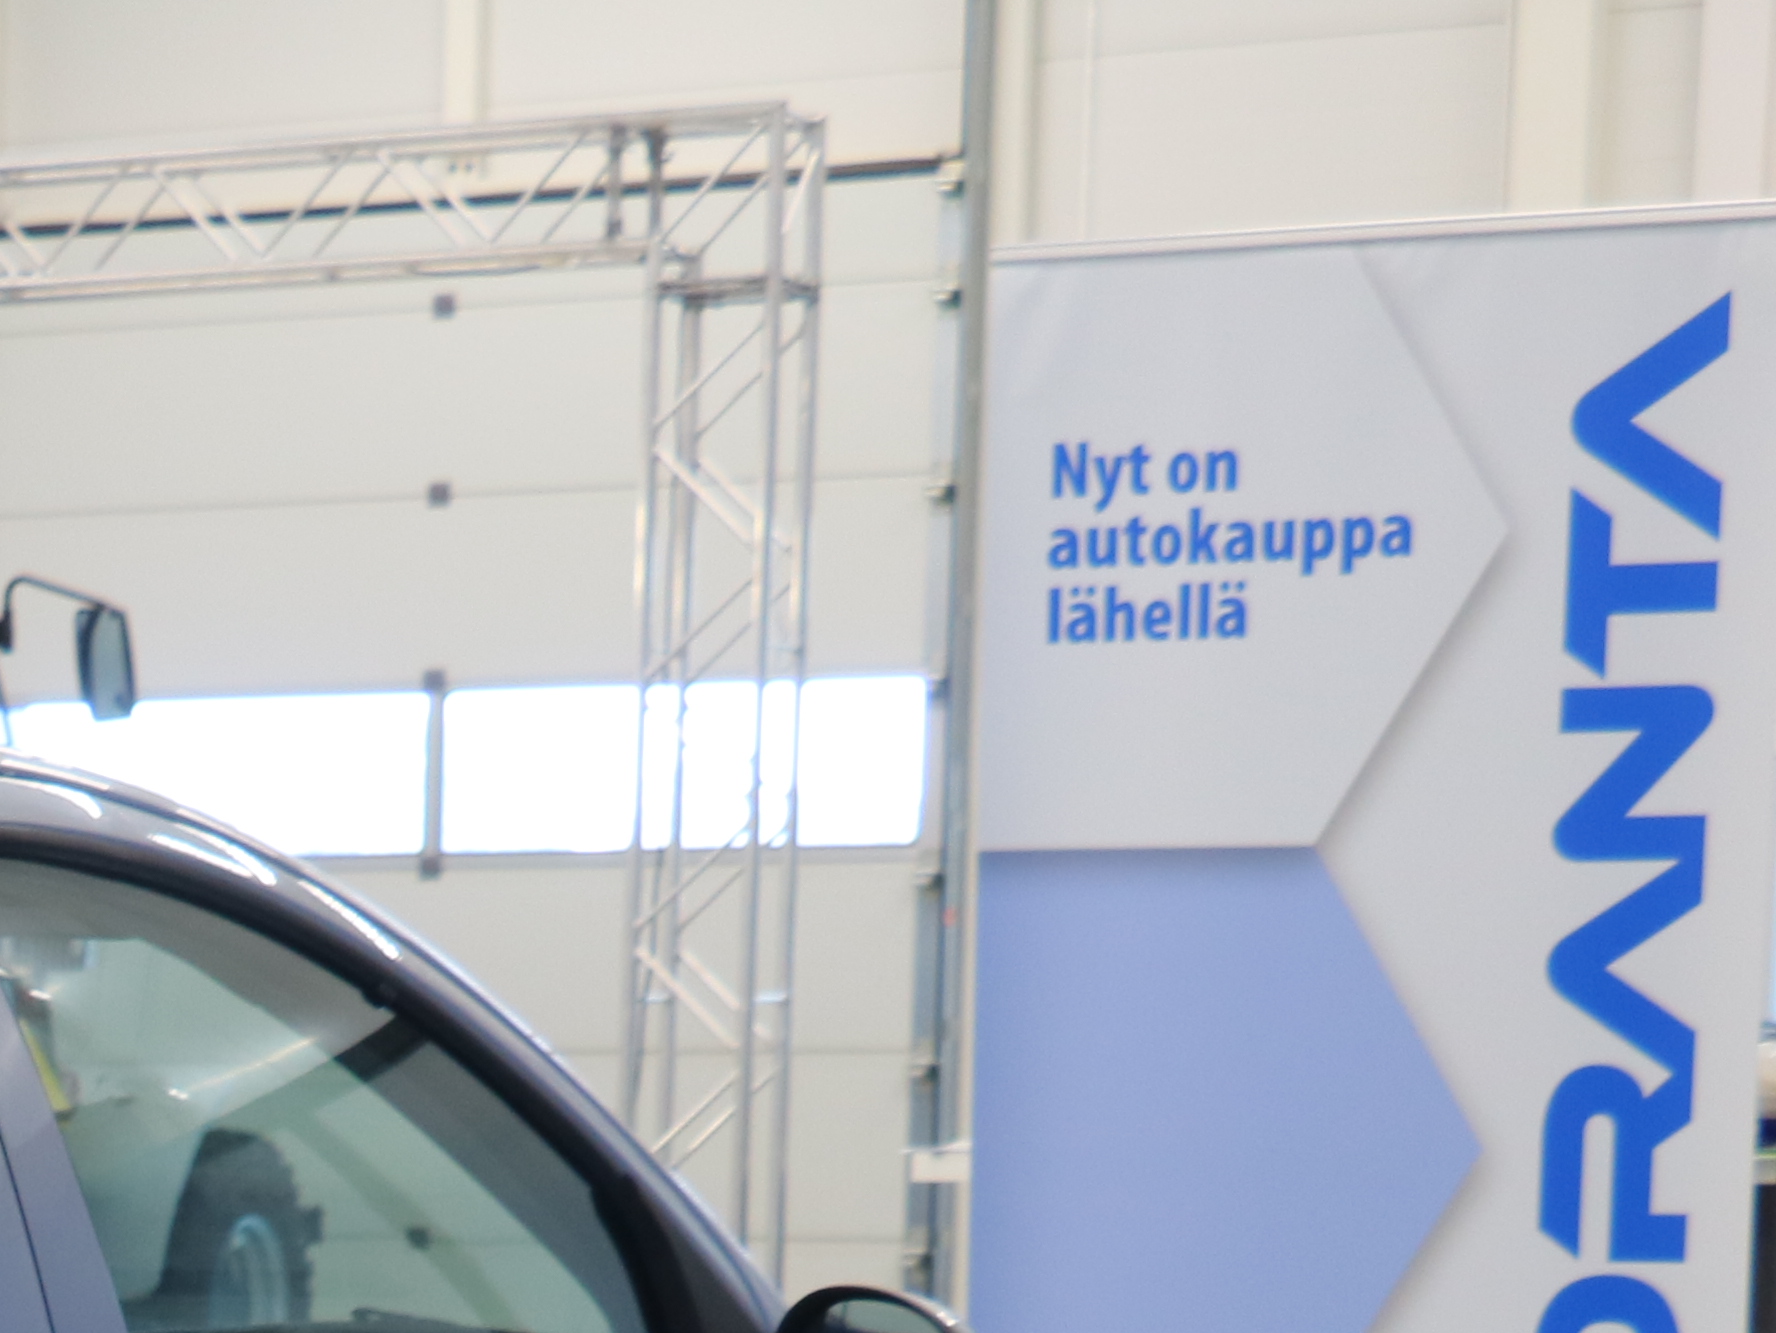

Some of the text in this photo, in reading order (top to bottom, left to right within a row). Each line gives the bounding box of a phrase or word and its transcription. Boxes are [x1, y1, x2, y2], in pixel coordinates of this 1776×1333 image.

[1052, 442, 1239, 513] Nyt on
[1047, 506, 1414, 577] autokauppa
[1046, 581, 1248, 644] lähellä
